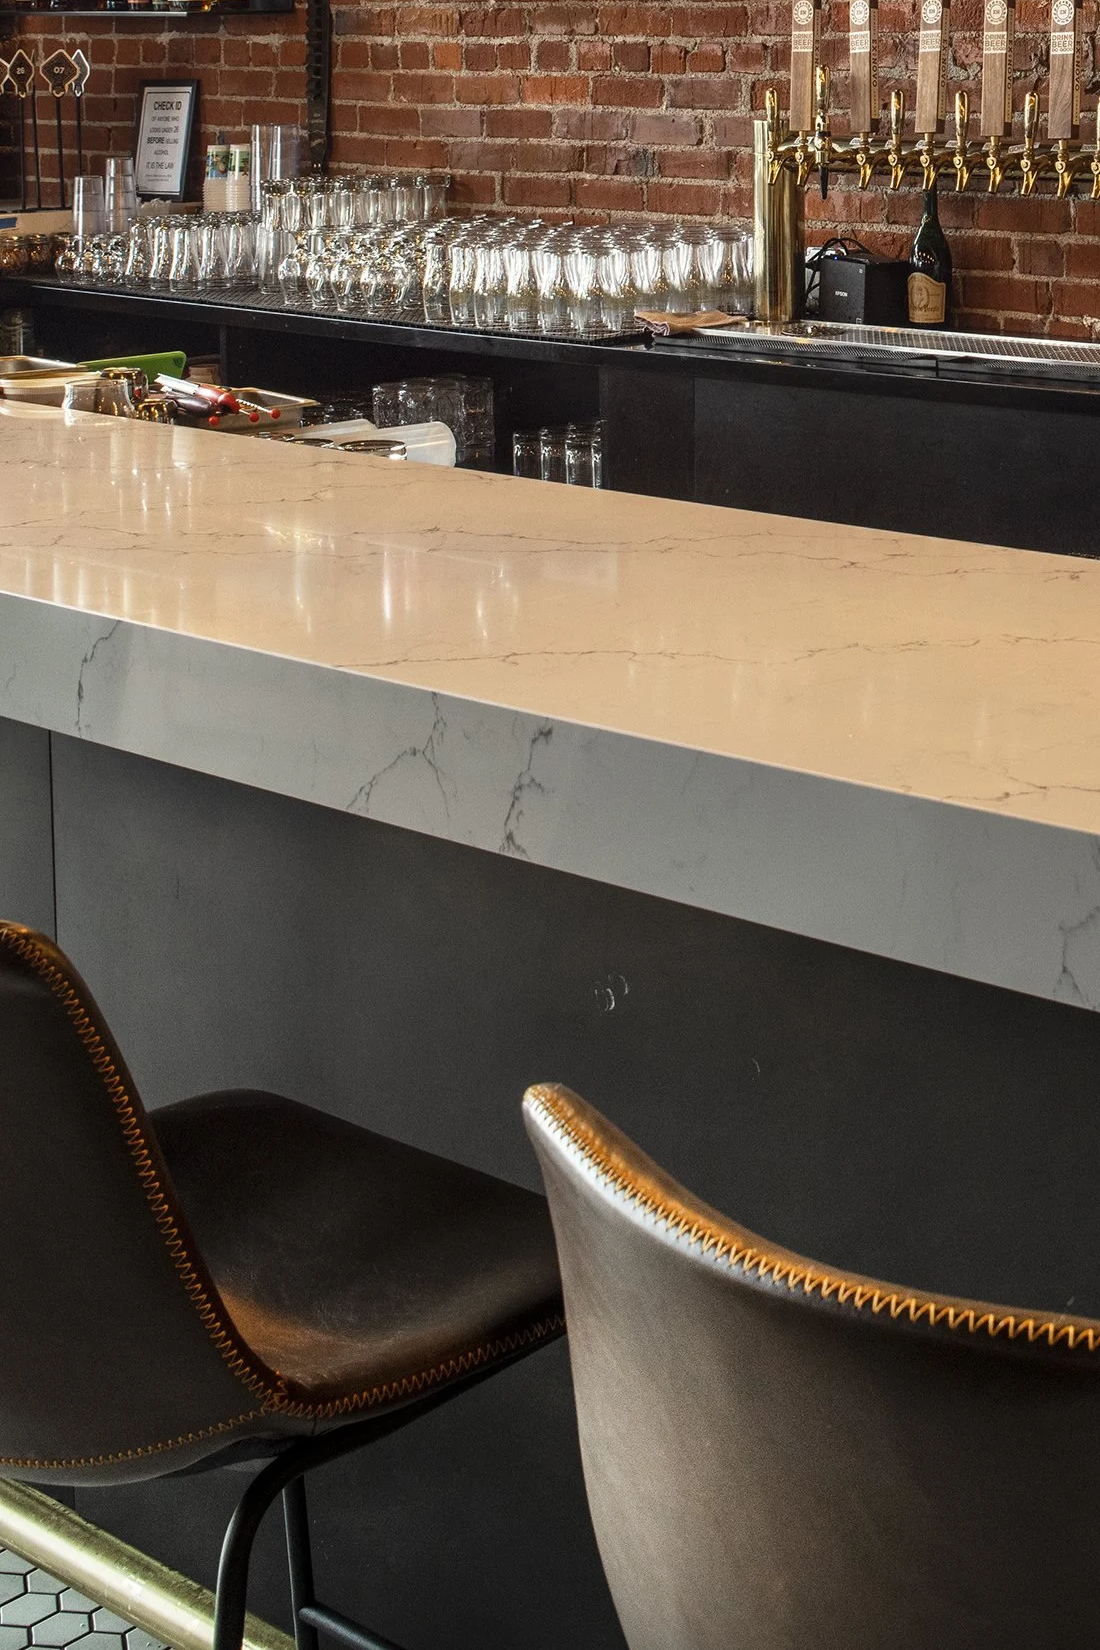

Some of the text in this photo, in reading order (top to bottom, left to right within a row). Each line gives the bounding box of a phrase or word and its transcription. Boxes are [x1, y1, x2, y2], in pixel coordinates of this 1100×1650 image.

[53, 66, 66, 74] 07
[153, 101, 182, 111] CHECK ID
[147, 136, 165, 144] BEFORE
[155, 161, 164, 170] THE
[164, 161, 175, 170] LAW
